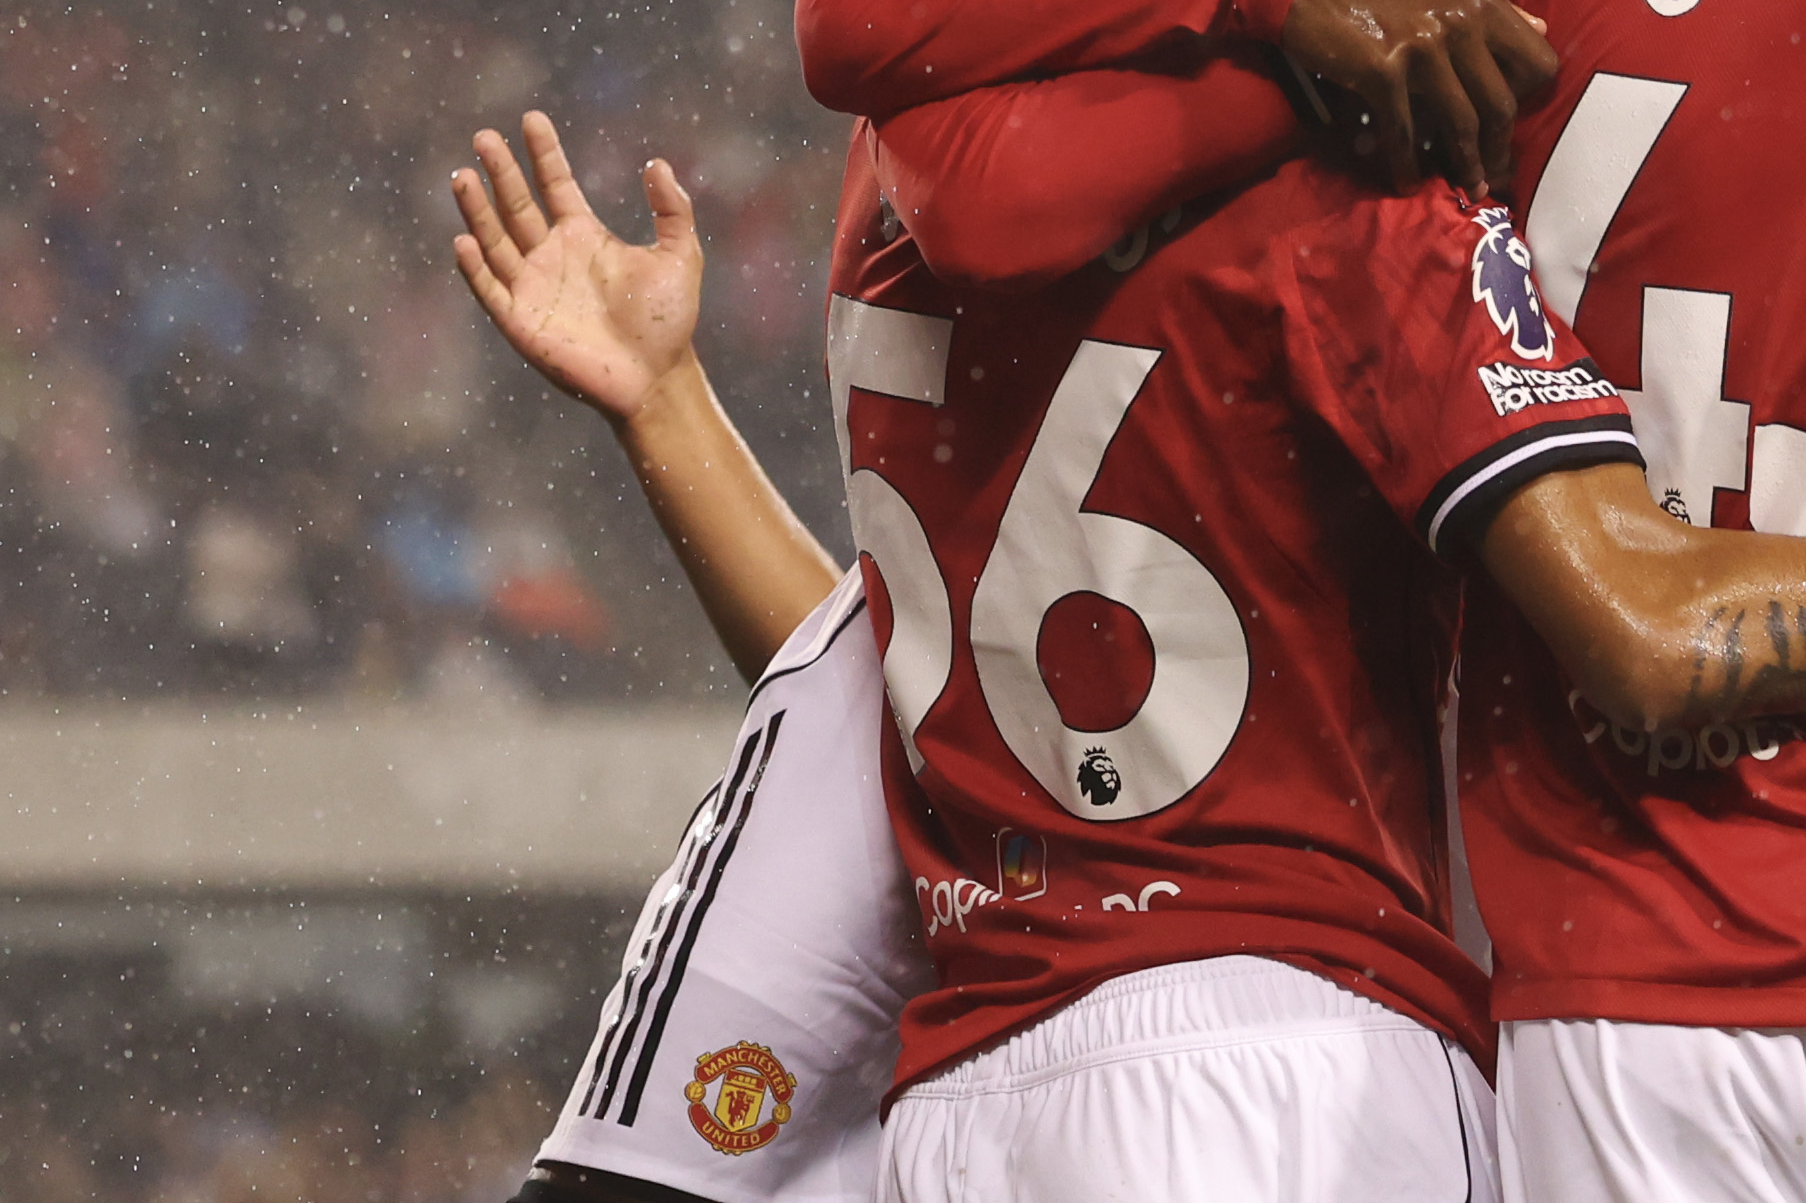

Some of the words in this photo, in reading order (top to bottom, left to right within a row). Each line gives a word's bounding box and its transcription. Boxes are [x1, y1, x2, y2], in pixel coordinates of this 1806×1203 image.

[1478, 362, 1524, 395] No
[1520, 366, 1593, 387] room
[1533, 379, 1618, 404] racism
[826, 291, 1251, 821] 56
[703, 1050, 786, 1094] MANCHESTER
[702, 1121, 760, 1147] UNITED
